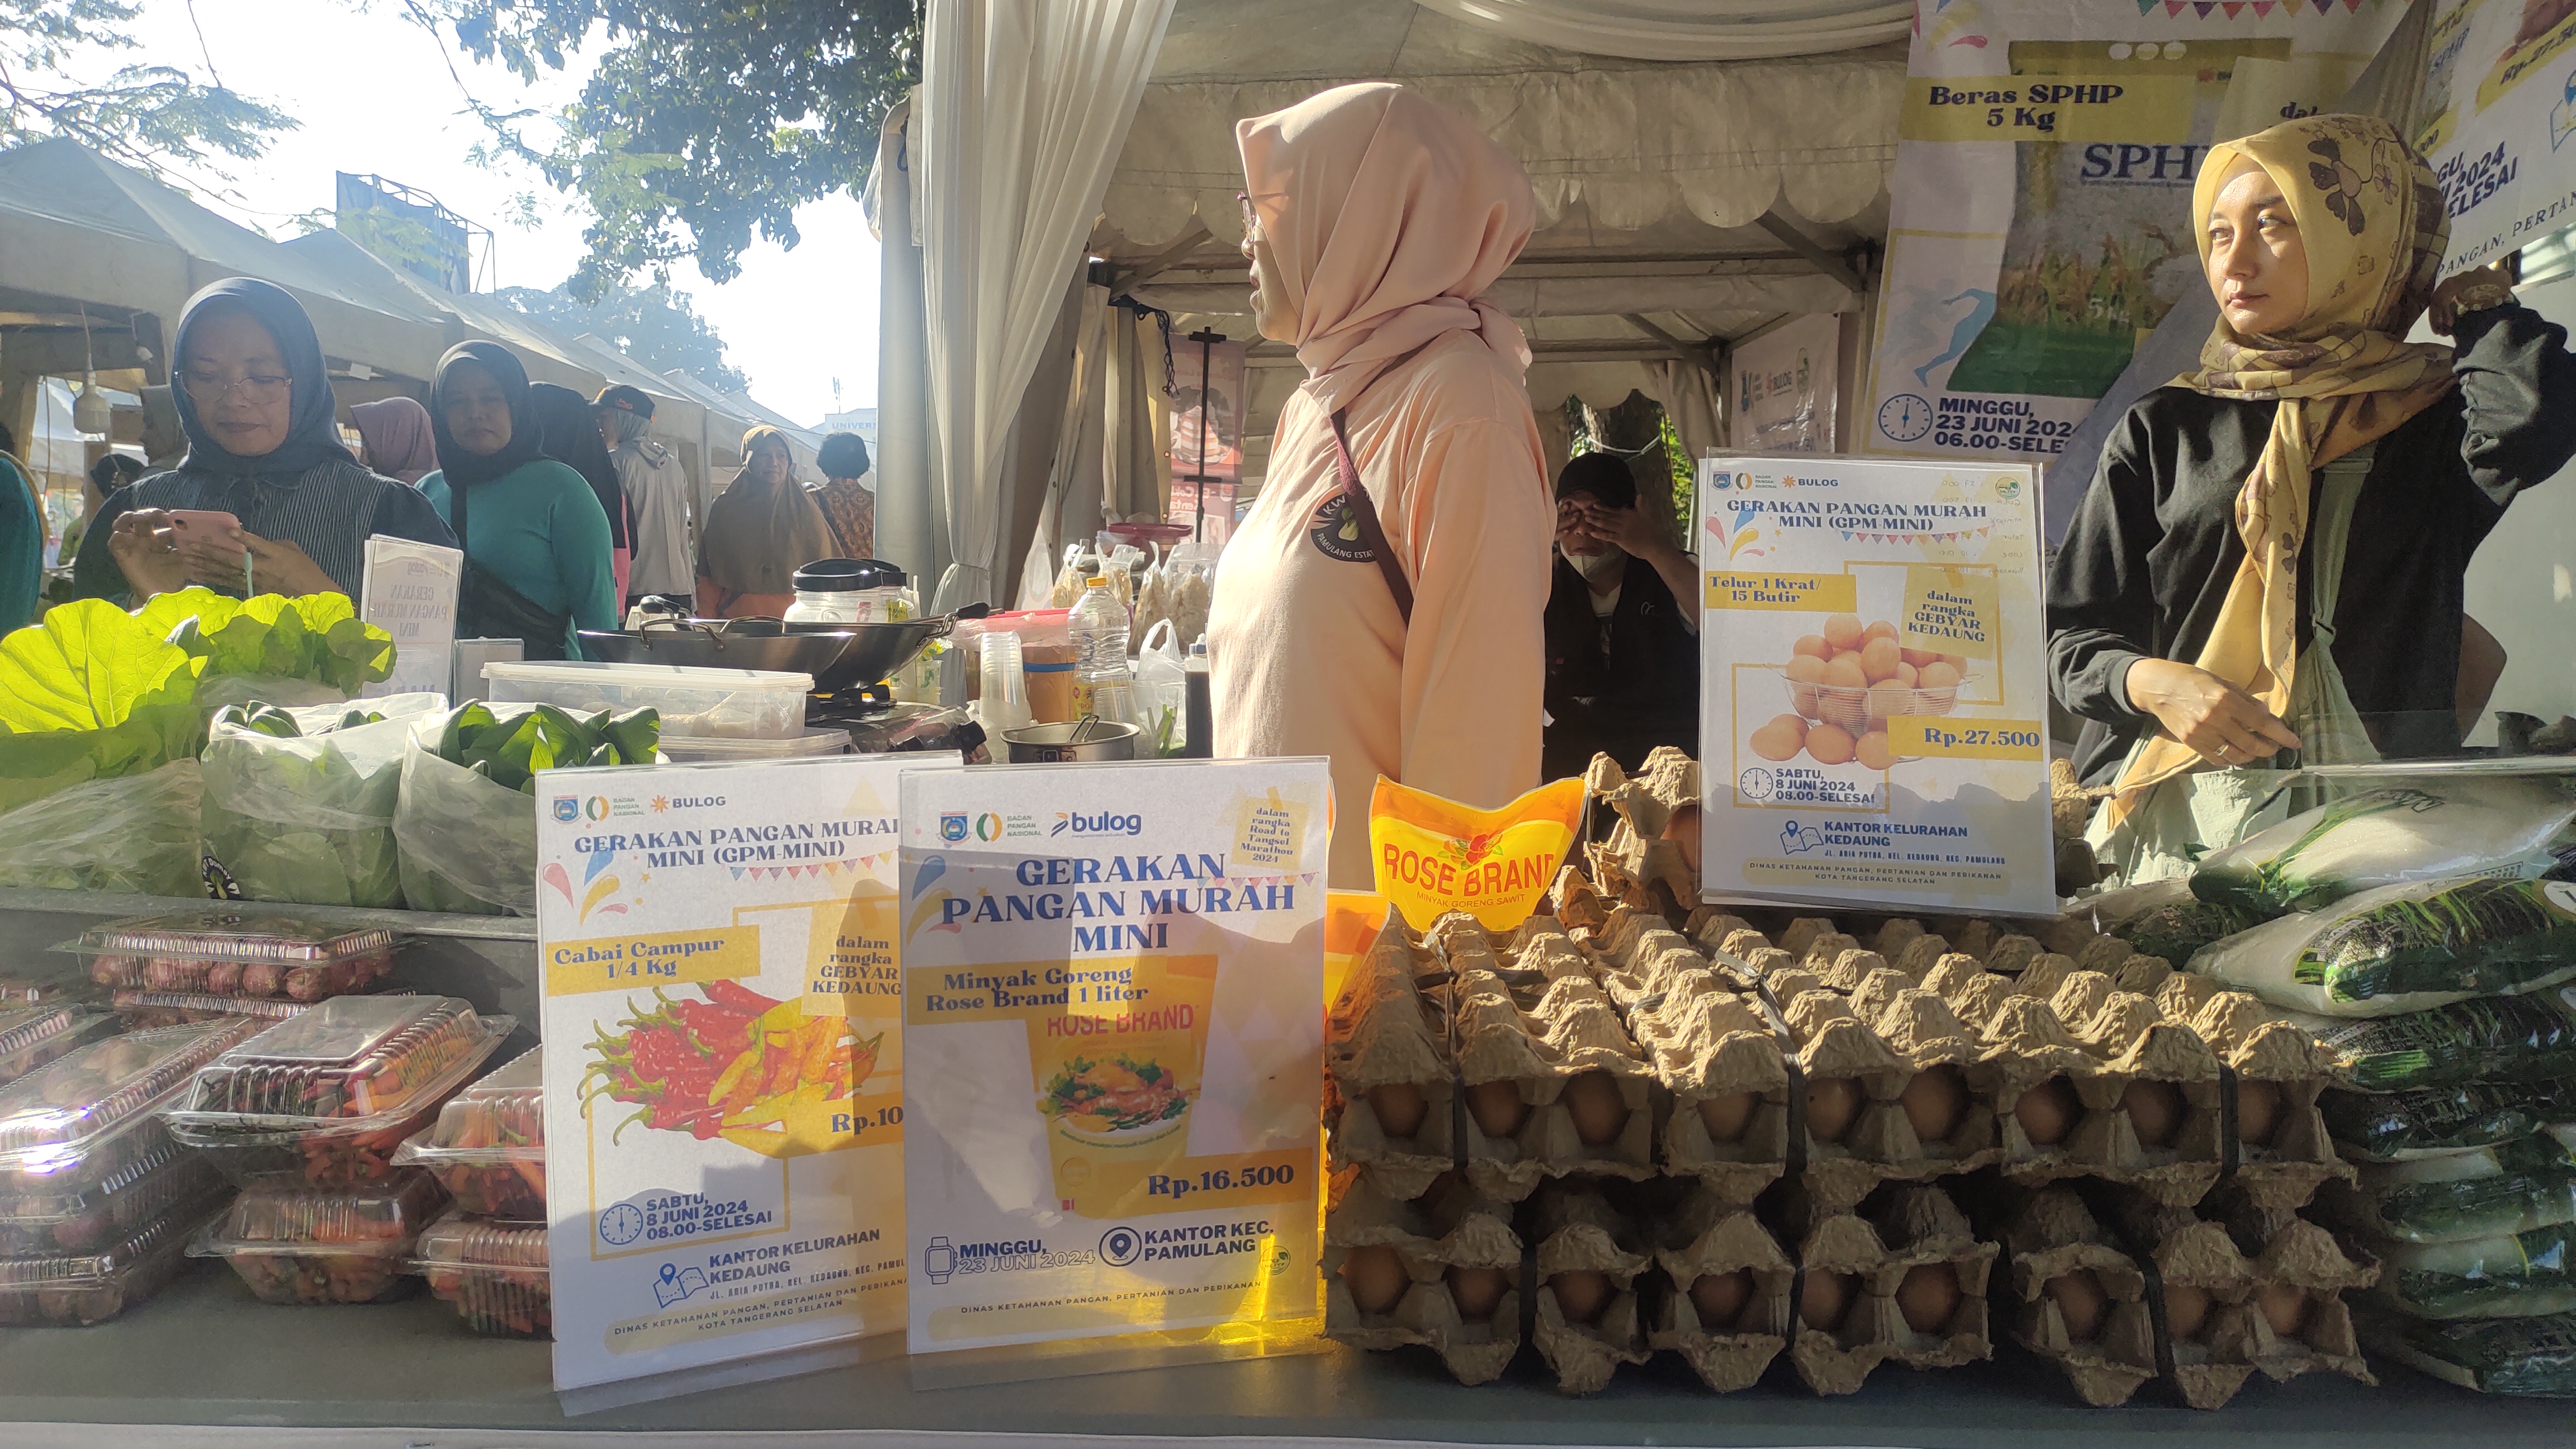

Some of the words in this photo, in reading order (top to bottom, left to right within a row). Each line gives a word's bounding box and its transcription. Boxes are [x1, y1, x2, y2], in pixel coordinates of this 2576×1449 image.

[1929, 86, 2017, 105] Beras
[2028, 84, 2123, 103] SPHP
[1987, 108, 2004, 127] 5
[2013, 107, 2056, 132] Kg
[2280, 101, 2318, 119] dal
[2080, 144, 2206, 180] SPH
[2452, 140, 2505, 198] 2024
[2448, 156, 2518, 219] ELESAI
[1939, 397, 2034, 419] MINGGU,
[1935, 415, 1966, 430] 23
[1970, 416, 2021, 434] JUNI
[2025, 420, 2076, 437] 202
[1934, 432, 2070, 453] 06.00-SELE
[1798, 478, 1839, 486] BULOG
[1322, 495, 1347, 515] KW
[1727, 500, 1820, 514] GERAKAN
[1826, 503, 1909, 517] PANGAN
[1914, 504, 1987, 518] MURAH
[1779, 515, 1822, 528] MINI
[1829, 515, 1934, 531] (GPM-MINI)
[1317, 532, 1352, 558] PAMULANG
[1354, 549, 1375, 558] ESTAT
[1710, 575, 1758, 589] Telur
[1762, 577, 1769, 589] 1
[1775, 578, 1822, 591] Krat/
[1731, 590, 1748, 603] 15
[1754, 590, 1801, 603] Butir
[1926, 590, 1973, 605] dalam
[1921, 601, 1976, 618] rangka
[1908, 622, 1985, 642] KEDAUNG
[1915, 612, 1981, 631] GEBYAR
[1924, 727, 2040, 748] Rp.27.500
[1775, 768, 1825, 780] SABTU,
[1775, 779, 1784, 789] 8
[1786, 779, 1817, 790] JUNI
[1819, 780, 1856, 792] 2024
[673, 796, 726, 808] BULOG
[1775, 790, 1875, 804] 08.00-SELESAI
[1072, 811, 1142, 835] bulog
[1252, 818, 1290, 827] rangka
[1256, 807, 1289, 818] dalam
[575, 829, 702, 853] GERAKAN
[711, 825, 818, 845] PANGAN
[1250, 825, 1276, 835] Road
[1824, 821, 1882, 834] KANTOR
[1883, 823, 1967, 837] KELURAHAN
[1240, 842, 1293, 855] Marathon
[1248, 834, 1289, 846] Tangsel
[1824, 834, 1891, 847] KEDAUNG
[647, 849, 705, 869] MINI
[714, 841, 845, 865] (GPM-MINI)
[1252, 853, 1278, 863] 2024
[1016, 853, 1226, 887] GERAKAN
[1384, 842, 1456, 896] ROSE
[1779, 863, 1831, 872] KETAHANAN
[1951, 872, 2001, 880] PERIKANAN
[941, 891, 1125, 925] PANGAN
[1139, 884, 1294, 917] MURAH
[1417, 891, 1449, 908] MINYAK
[1451, 899, 1493, 908] GORENG
[1497, 894, 1526, 905] SAWIT
[836, 935, 889, 950] dalam
[1073, 922, 1168, 953] MINI
[554, 946, 623, 966] Cabai
[631, 937, 725, 959] Campur
[830, 951, 892, 967] rangka
[607, 960, 639, 979] 1/4
[646, 958, 677, 977] Kg
[820, 964, 898, 980] GEBYAR
[812, 979, 901, 996] KEDAUNG
[944, 969, 1037, 993] Minyak
[1045, 967, 1132, 987] Goreng
[926, 993, 984, 1012] Rose
[993, 988, 1069, 1008] Brand
[1079, 987, 1087, 1003] 1
[1096, 985, 1149, 1002] liter
[1116, 1003, 1195, 1034] BRAND
[1148, 1164, 1294, 1200] Rp.16.500
[646, 1192, 709, 1211] SABTU,
[646, 1211, 659, 1227] 8
[661, 1206, 699, 1225] JUNI
[703, 1199, 749, 1219] 2024
[646, 1211, 772, 1241] 08.00-SELESAI
[1144, 1224, 1227, 1244] KANTOR
[1231, 1220, 1274, 1237] KEC.
[709, 1246, 779, 1268] KANTOR
[783, 1229, 880, 1256] KELURAHAN
[960, 1239, 1047, 1258] MINGGU,
[1144, 1239, 1256, 1262] PAMULANG
[710, 1260, 791, 1284] KEDAUNG
[959, 1257, 987, 1275] 23
[991, 1254, 1037, 1272] JUNI
[1040, 1249, 1096, 1268] 2024
[961, 1305, 994, 1314] DINAS
[998, 1300, 1062, 1311] KETAHANAN
[1066, 1295, 1112, 1305] PANGAN,
[1116, 1290, 1175, 1301] PERTANIAN
[1178, 1287, 1200, 1295] DAN
[1204, 1281, 1261, 1293] PERIKANAN
[614, 1323, 648, 1335] DINAS
[653, 1310, 718, 1329] KETAHANAN
[723, 1303, 769, 1317] PANGAN,
[774, 1291, 832, 1308] PERTANIAN
[836, 1287, 857, 1297] DAN
[698, 1320, 726, 1330] KOTA
[731, 1308, 794, 1325] TANGERANG
[798, 1299, 842, 1314] SELATAN
